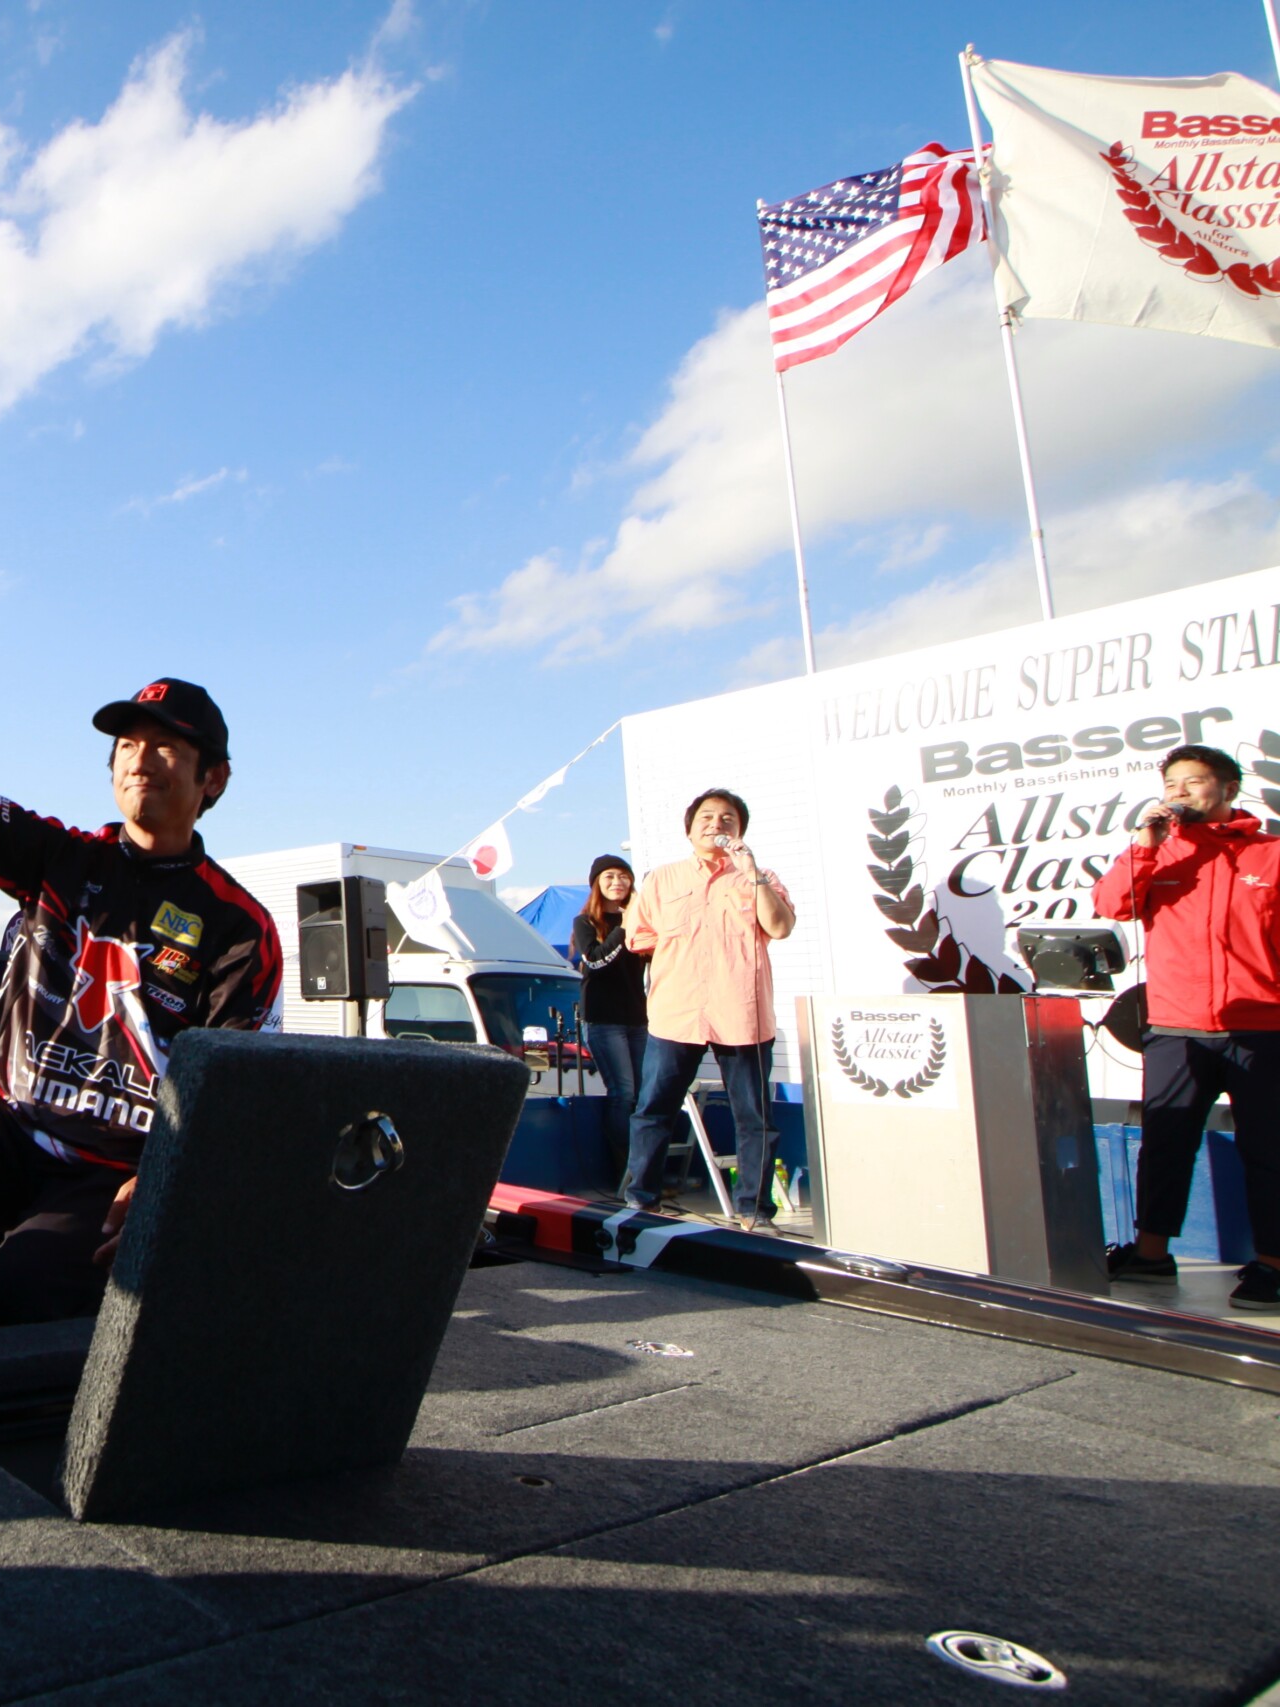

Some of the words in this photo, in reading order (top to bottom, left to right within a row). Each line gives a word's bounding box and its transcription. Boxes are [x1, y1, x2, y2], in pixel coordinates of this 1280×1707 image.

[1153, 138, 1200, 149] Monthly
[1201, 133, 1265, 147] Bassfishing
[1153, 190, 1280, 229] Classi
[1193, 230, 1249, 257] Allstars
[1212, 229, 1233, 241] for
[822, 664, 997, 746] WELCOME
[1017, 632, 1153, 711] SUPER
[919, 706, 1234, 783] Basser
[943, 780, 1008, 798] Monthly
[1014, 766, 1120, 789] Bassfishing
[947, 845, 1122, 898] Clas
[158, 908, 201, 940] NBC
[850, 1010, 921, 1022] Basser
[853, 1043, 922, 1060] Classic
[856, 1027, 924, 1044] Allstar
[28, 1074, 154, 1133] IMANO
